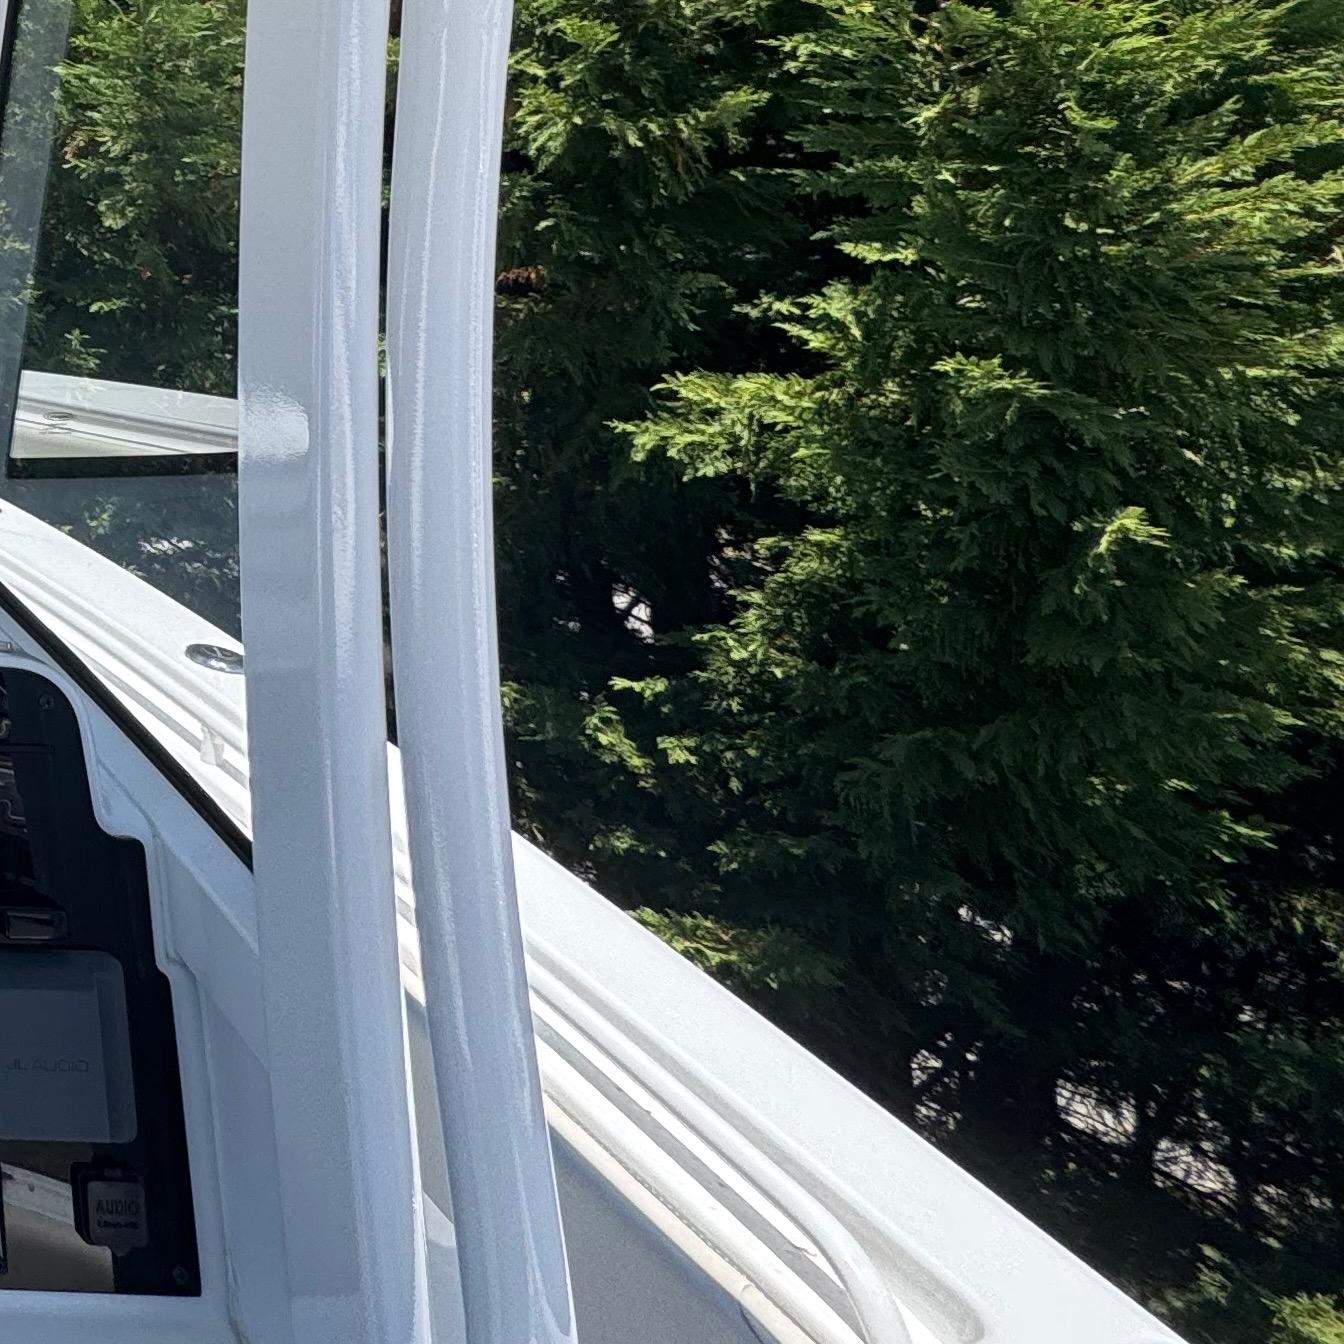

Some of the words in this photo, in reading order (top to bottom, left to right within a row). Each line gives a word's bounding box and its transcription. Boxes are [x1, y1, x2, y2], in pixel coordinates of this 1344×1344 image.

[7, 1058, 28, 1071] JL
[31, 1058, 90, 1073] AUDIO
[96, 1199, 138, 1216] AUDIO
